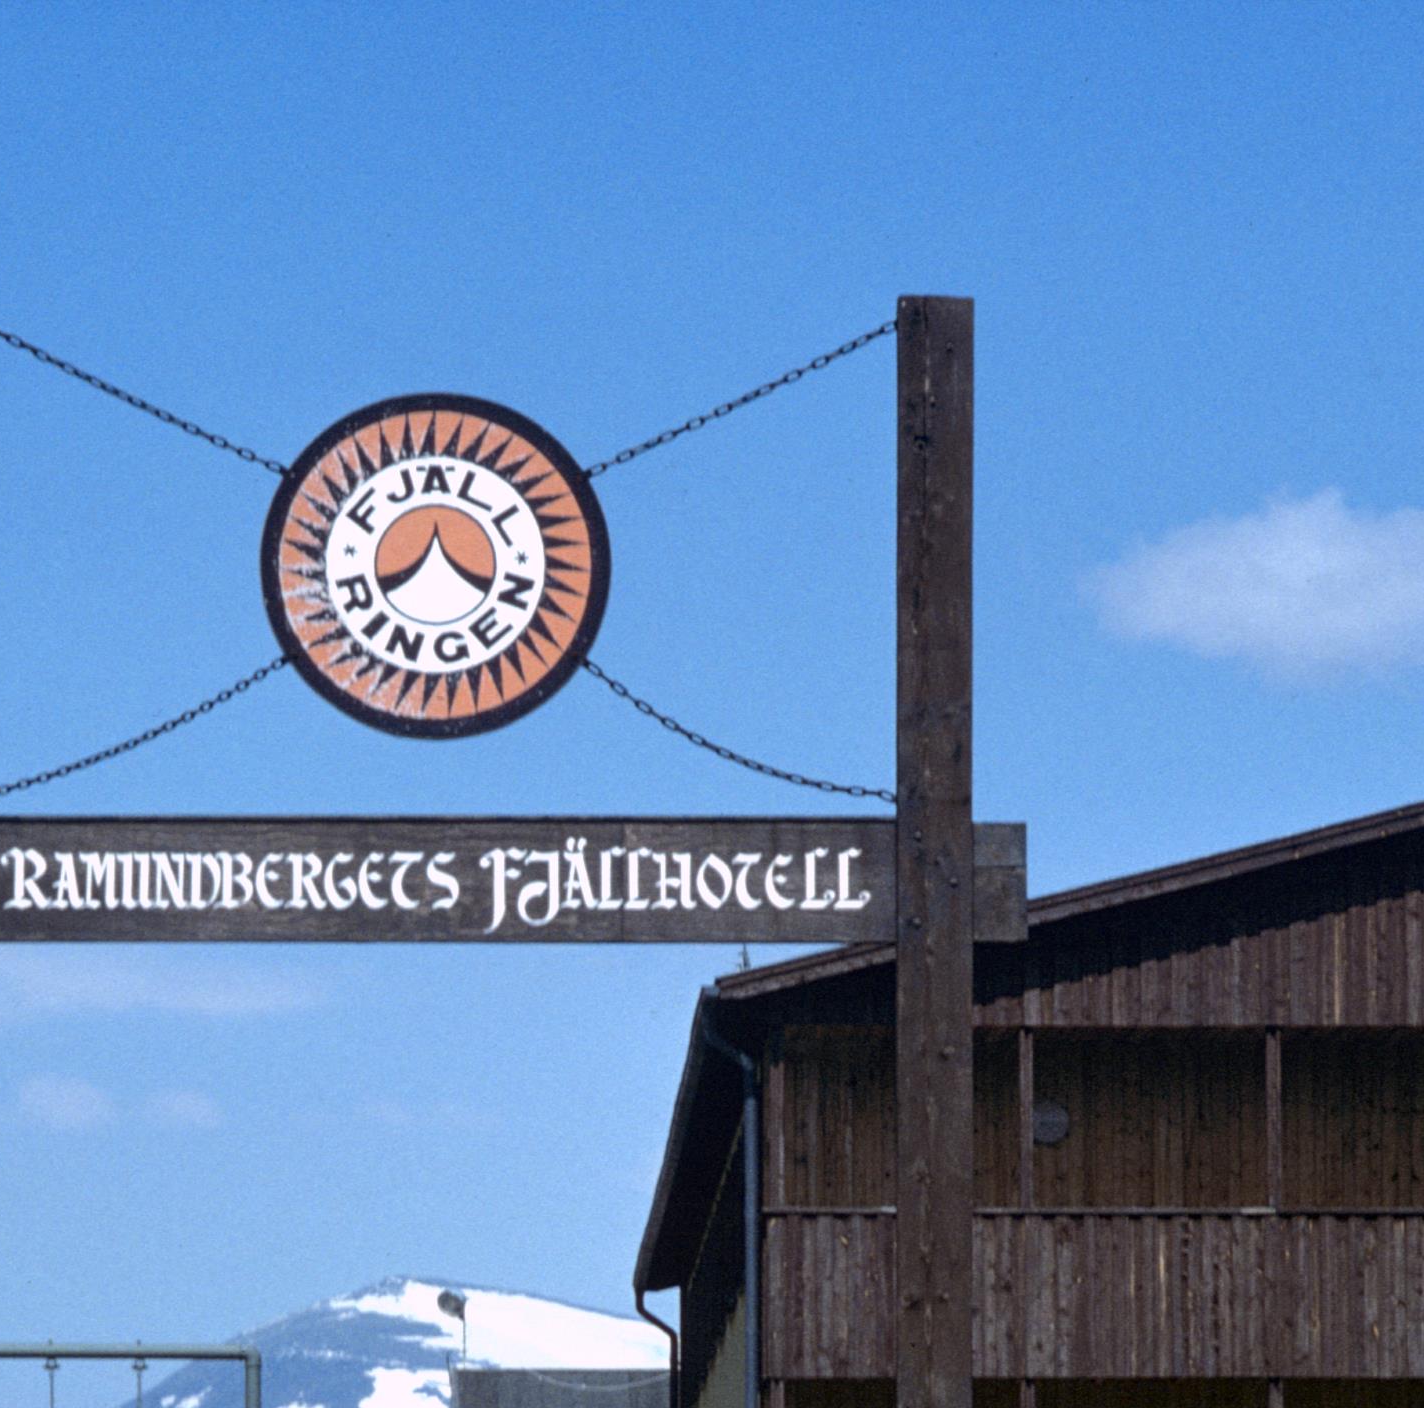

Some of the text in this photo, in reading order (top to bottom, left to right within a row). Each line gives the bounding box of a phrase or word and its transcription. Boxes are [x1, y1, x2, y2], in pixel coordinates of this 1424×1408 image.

[346, 464, 519, 547] FJÄLL
[335, 573, 535, 664] RINGEN
[479, 836, 870, 934] FJÄLLHOTELL
